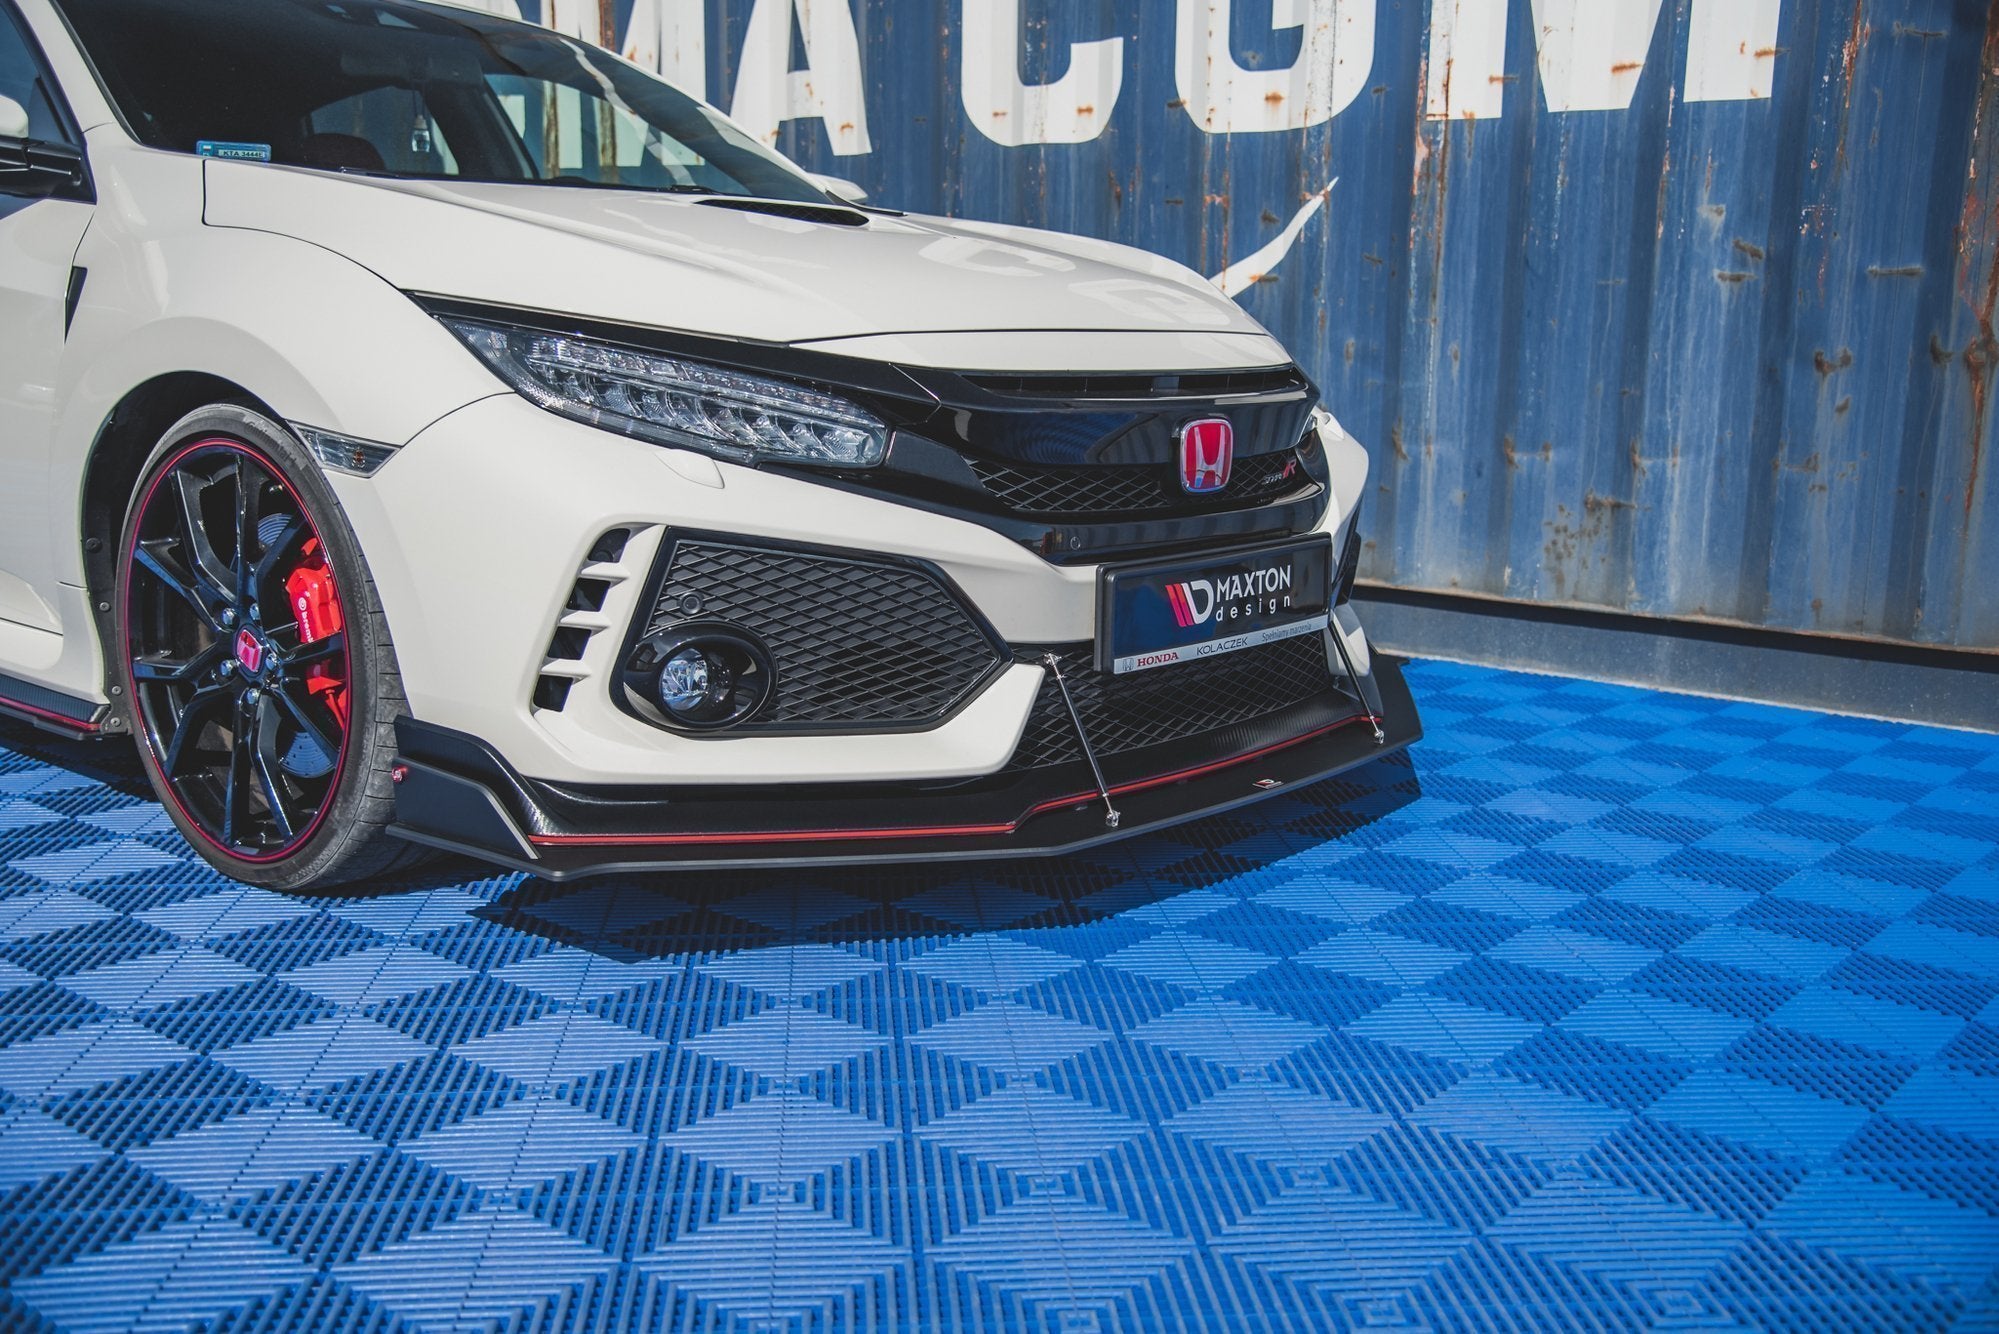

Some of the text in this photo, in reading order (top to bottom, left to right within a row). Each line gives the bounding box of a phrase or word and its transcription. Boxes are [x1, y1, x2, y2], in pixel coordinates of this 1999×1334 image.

[1217, 565, 1291, 603] MAXTON
[1215, 595, 1290, 622] design
[1137, 652, 1179, 667] HONDA
[1196, 637, 1248, 656] KOLACZEK
